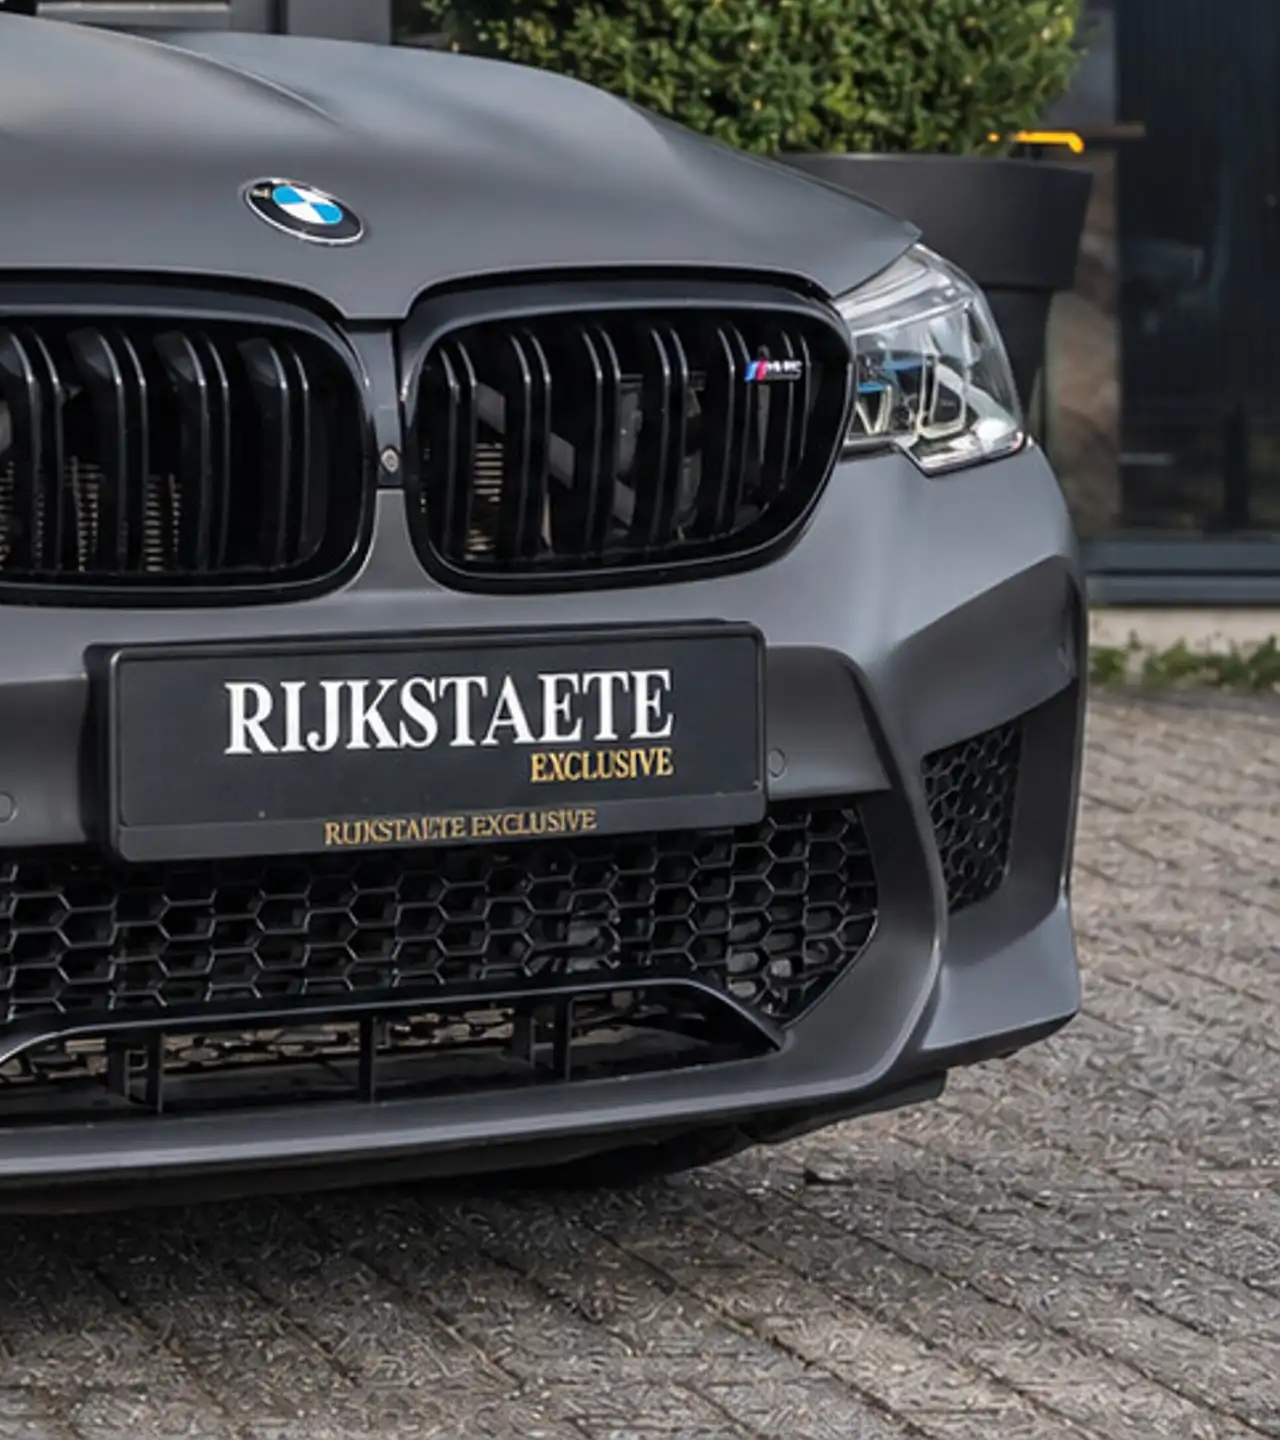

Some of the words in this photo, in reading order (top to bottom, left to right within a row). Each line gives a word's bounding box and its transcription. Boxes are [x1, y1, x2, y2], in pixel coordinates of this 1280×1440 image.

[224, 669, 674, 756] RIJKSTAETE
[530, 747, 674, 783] EXCLUSIVE
[472, 808, 598, 837] EXCLUSIVE
